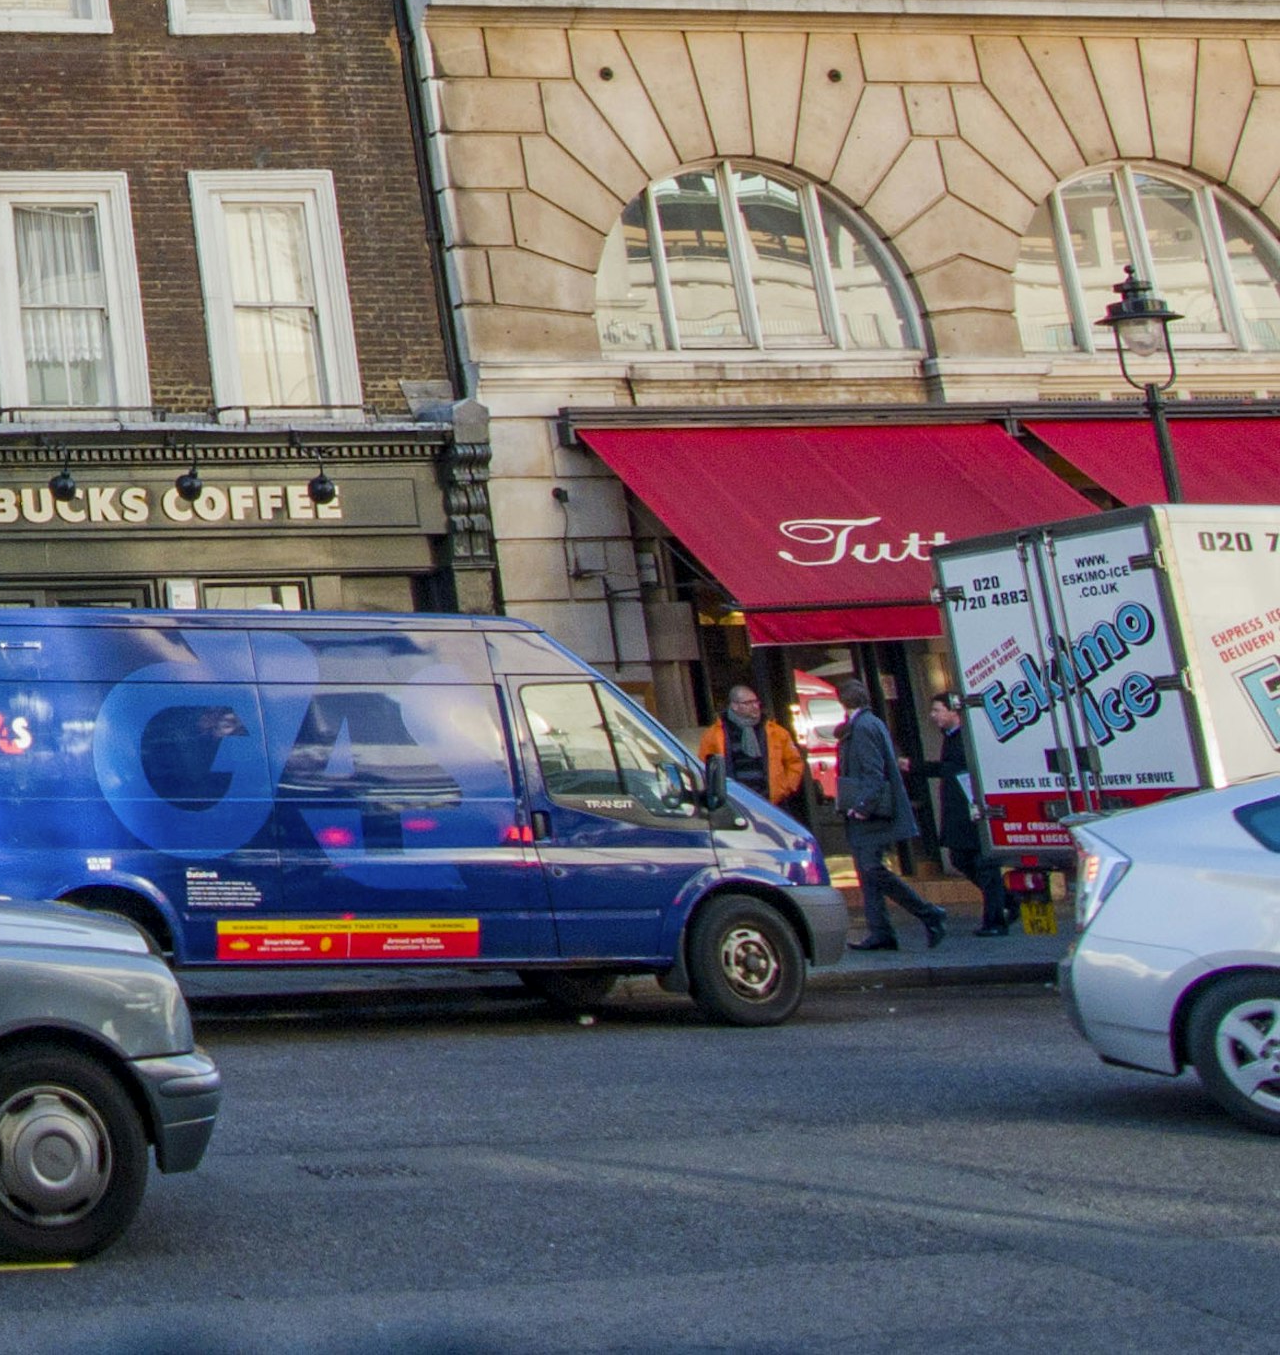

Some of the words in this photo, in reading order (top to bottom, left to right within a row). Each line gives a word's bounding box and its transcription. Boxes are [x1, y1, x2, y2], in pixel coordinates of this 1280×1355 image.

[162, 484, 343, 523] COFFEE
[1198, 531, 1253, 552] 020
[1074, 553, 1109, 569] WWW.
[973, 575, 1000, 592] 020
[1061, 565, 1131, 586] ESKIMO-ICE
[953, 594, 987, 612] 7720
[991, 590, 1029, 607] 4883
[1079, 582, 1120, 599] .CO.UK
[1211, 617, 1263, 647] EXPRESS
[1219, 630, 1275, 663] DELIVERY
[964, 651, 990, 679] EXPRESS
[968, 660, 997, 688] DELIVERY
[996, 646, 1021, 672] SERVICE
[979, 601, 1155, 743] Eskimo
[1080, 670, 1161, 747] Ice
[998, 777, 1035, 789] EXPRESS
[1039, 776, 1052, 788] ICE
[1055, 776, 1076, 787] CUE
[1088, 773, 1132, 787] DLIVERY
[1136, 771, 1175, 784] SERVICE
[584, 800, 634, 809] TRANSIT
